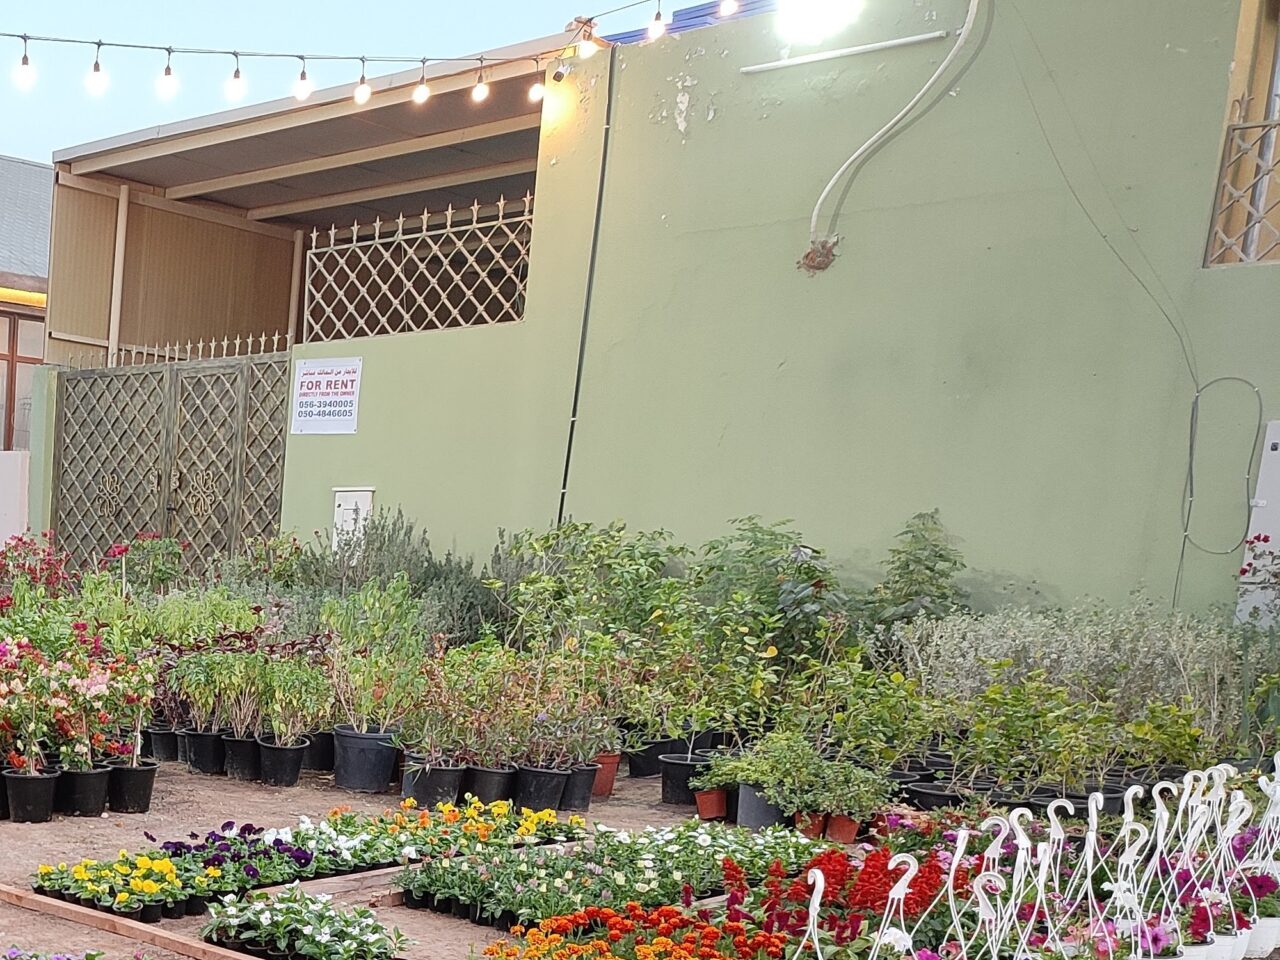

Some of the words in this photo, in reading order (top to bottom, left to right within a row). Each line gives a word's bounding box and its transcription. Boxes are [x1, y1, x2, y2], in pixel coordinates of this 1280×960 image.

[300, 380, 322, 390] FOR
[326, 379, 356, 390] RENT
[299, 400, 354, 408] 056-3940005
[298, 409, 353, 417] 050-4846605
